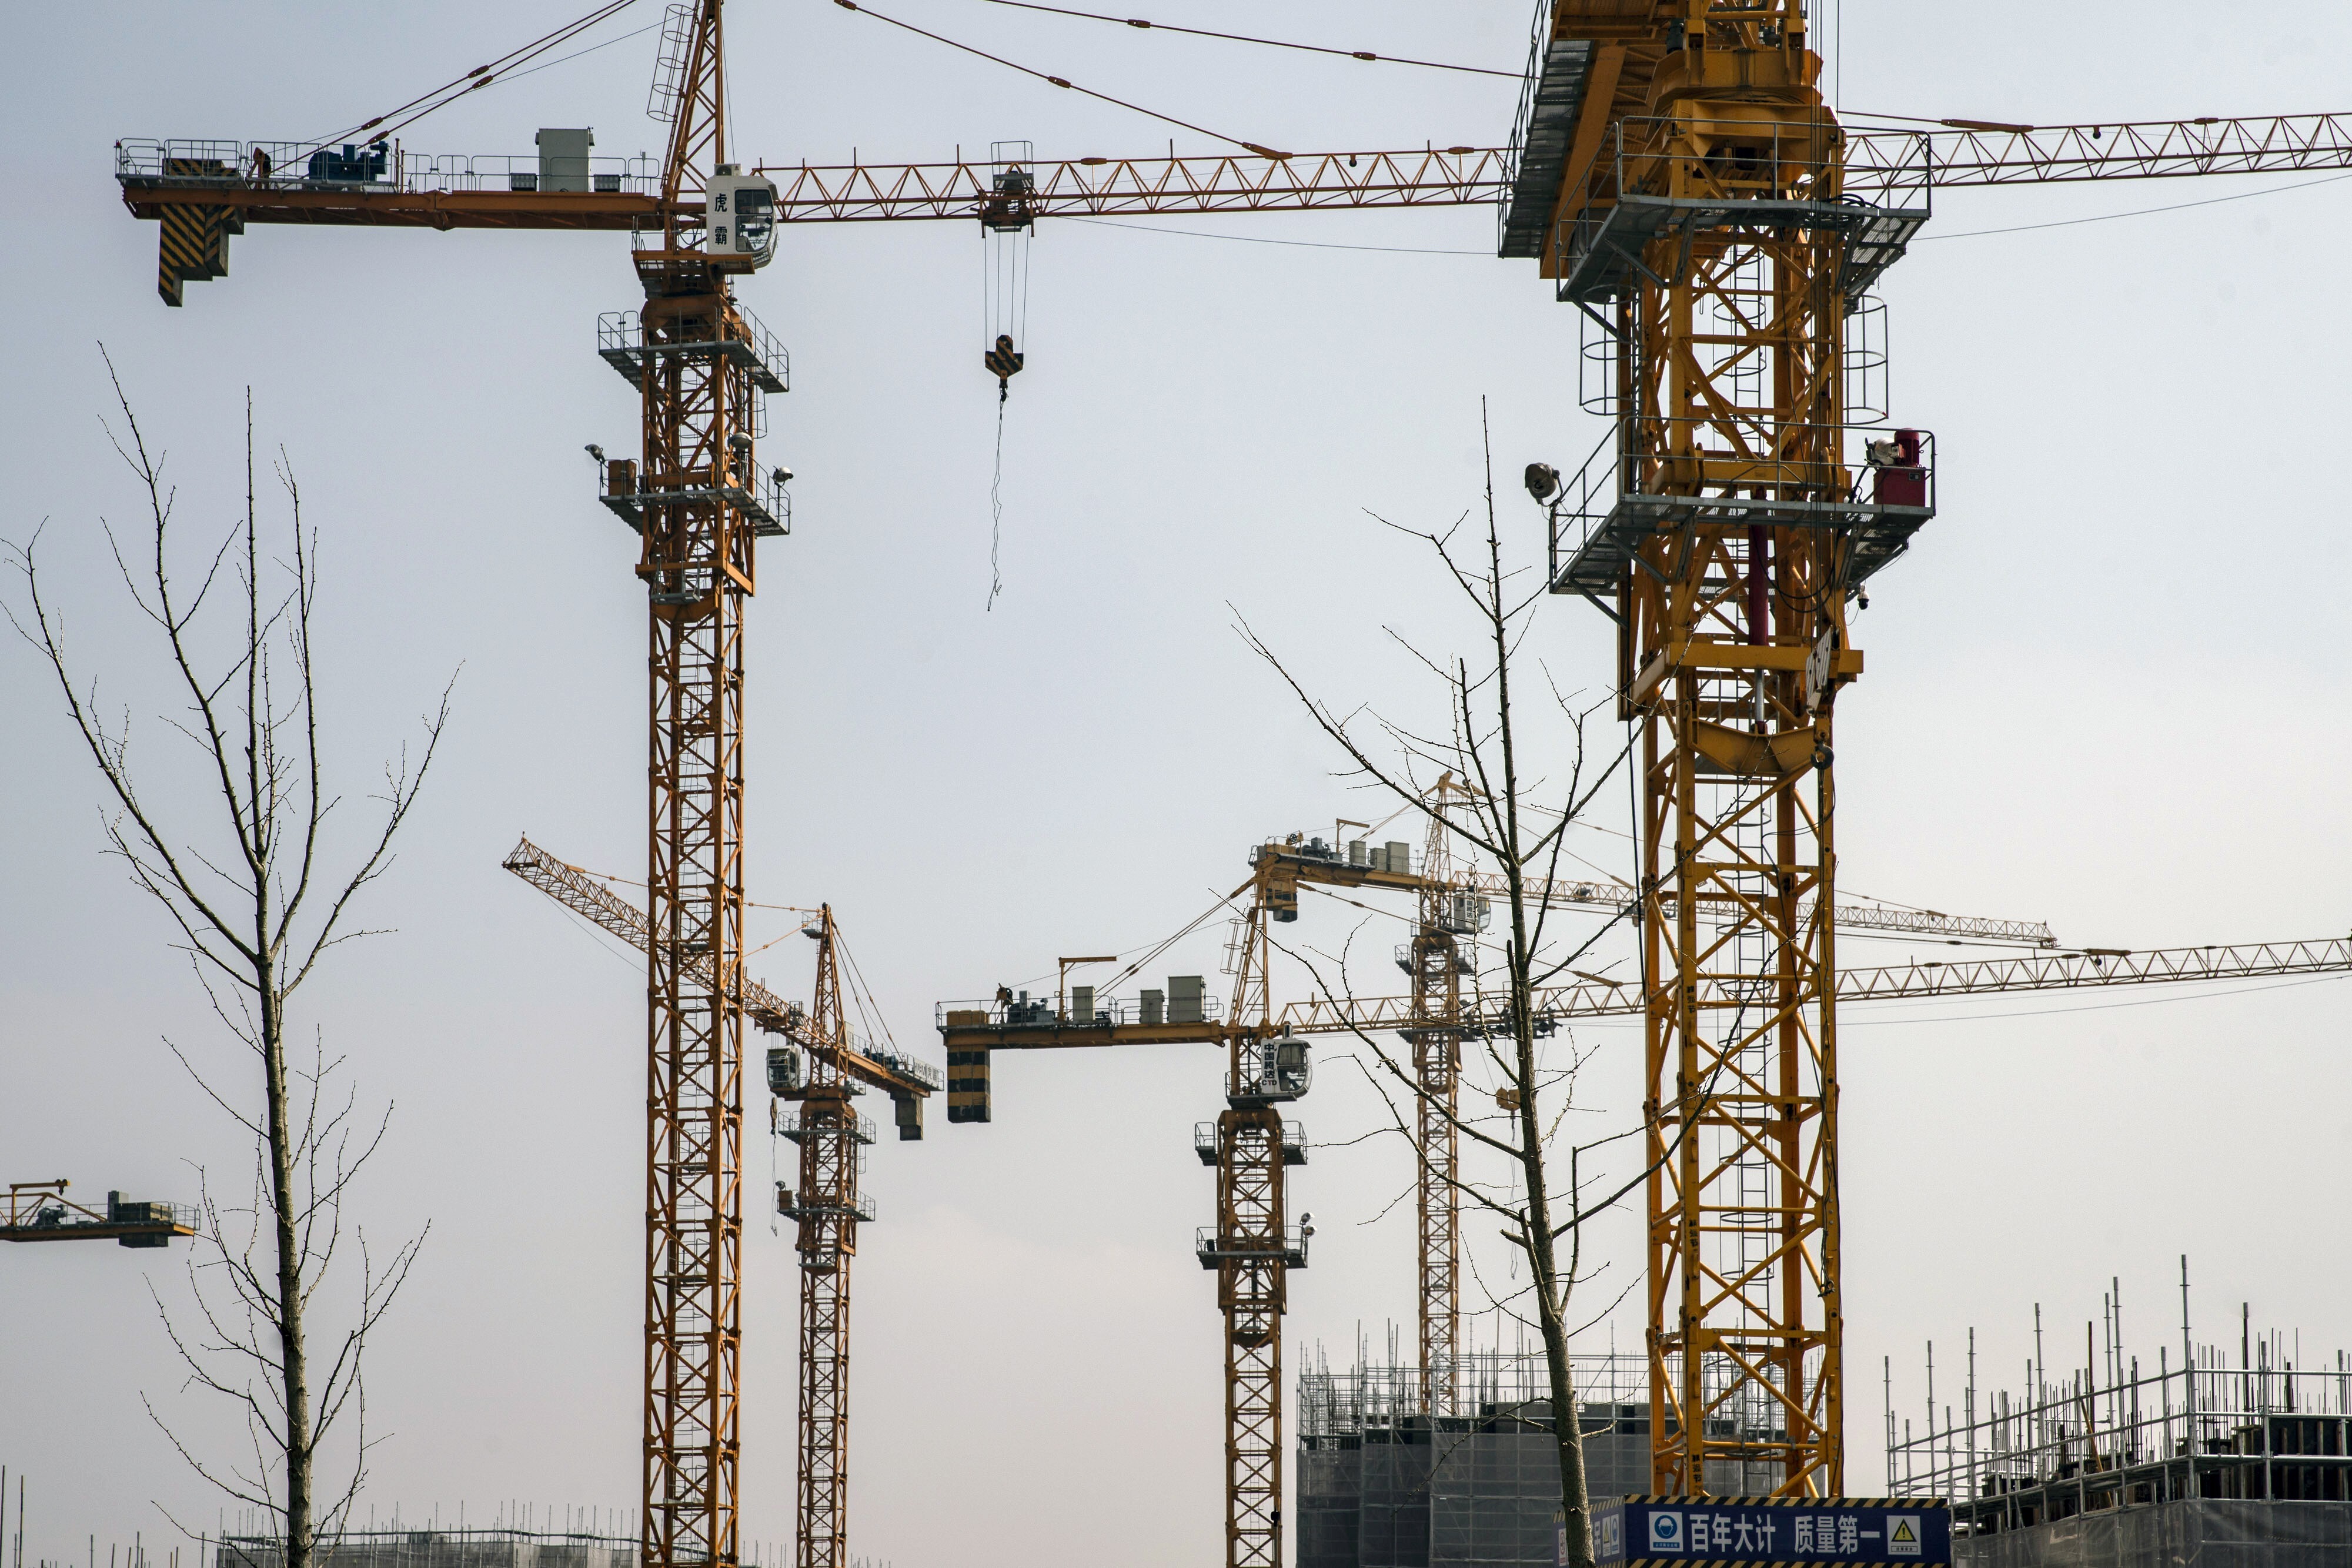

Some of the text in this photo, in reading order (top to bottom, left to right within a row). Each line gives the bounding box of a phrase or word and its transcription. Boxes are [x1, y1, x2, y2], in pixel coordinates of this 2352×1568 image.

[714, 193, 727, 245] 虎霸
[1264, 1043, 1275, 1079] 中国腾达
[1689, 1513, 1880, 1554] 百年大计 质量第一
